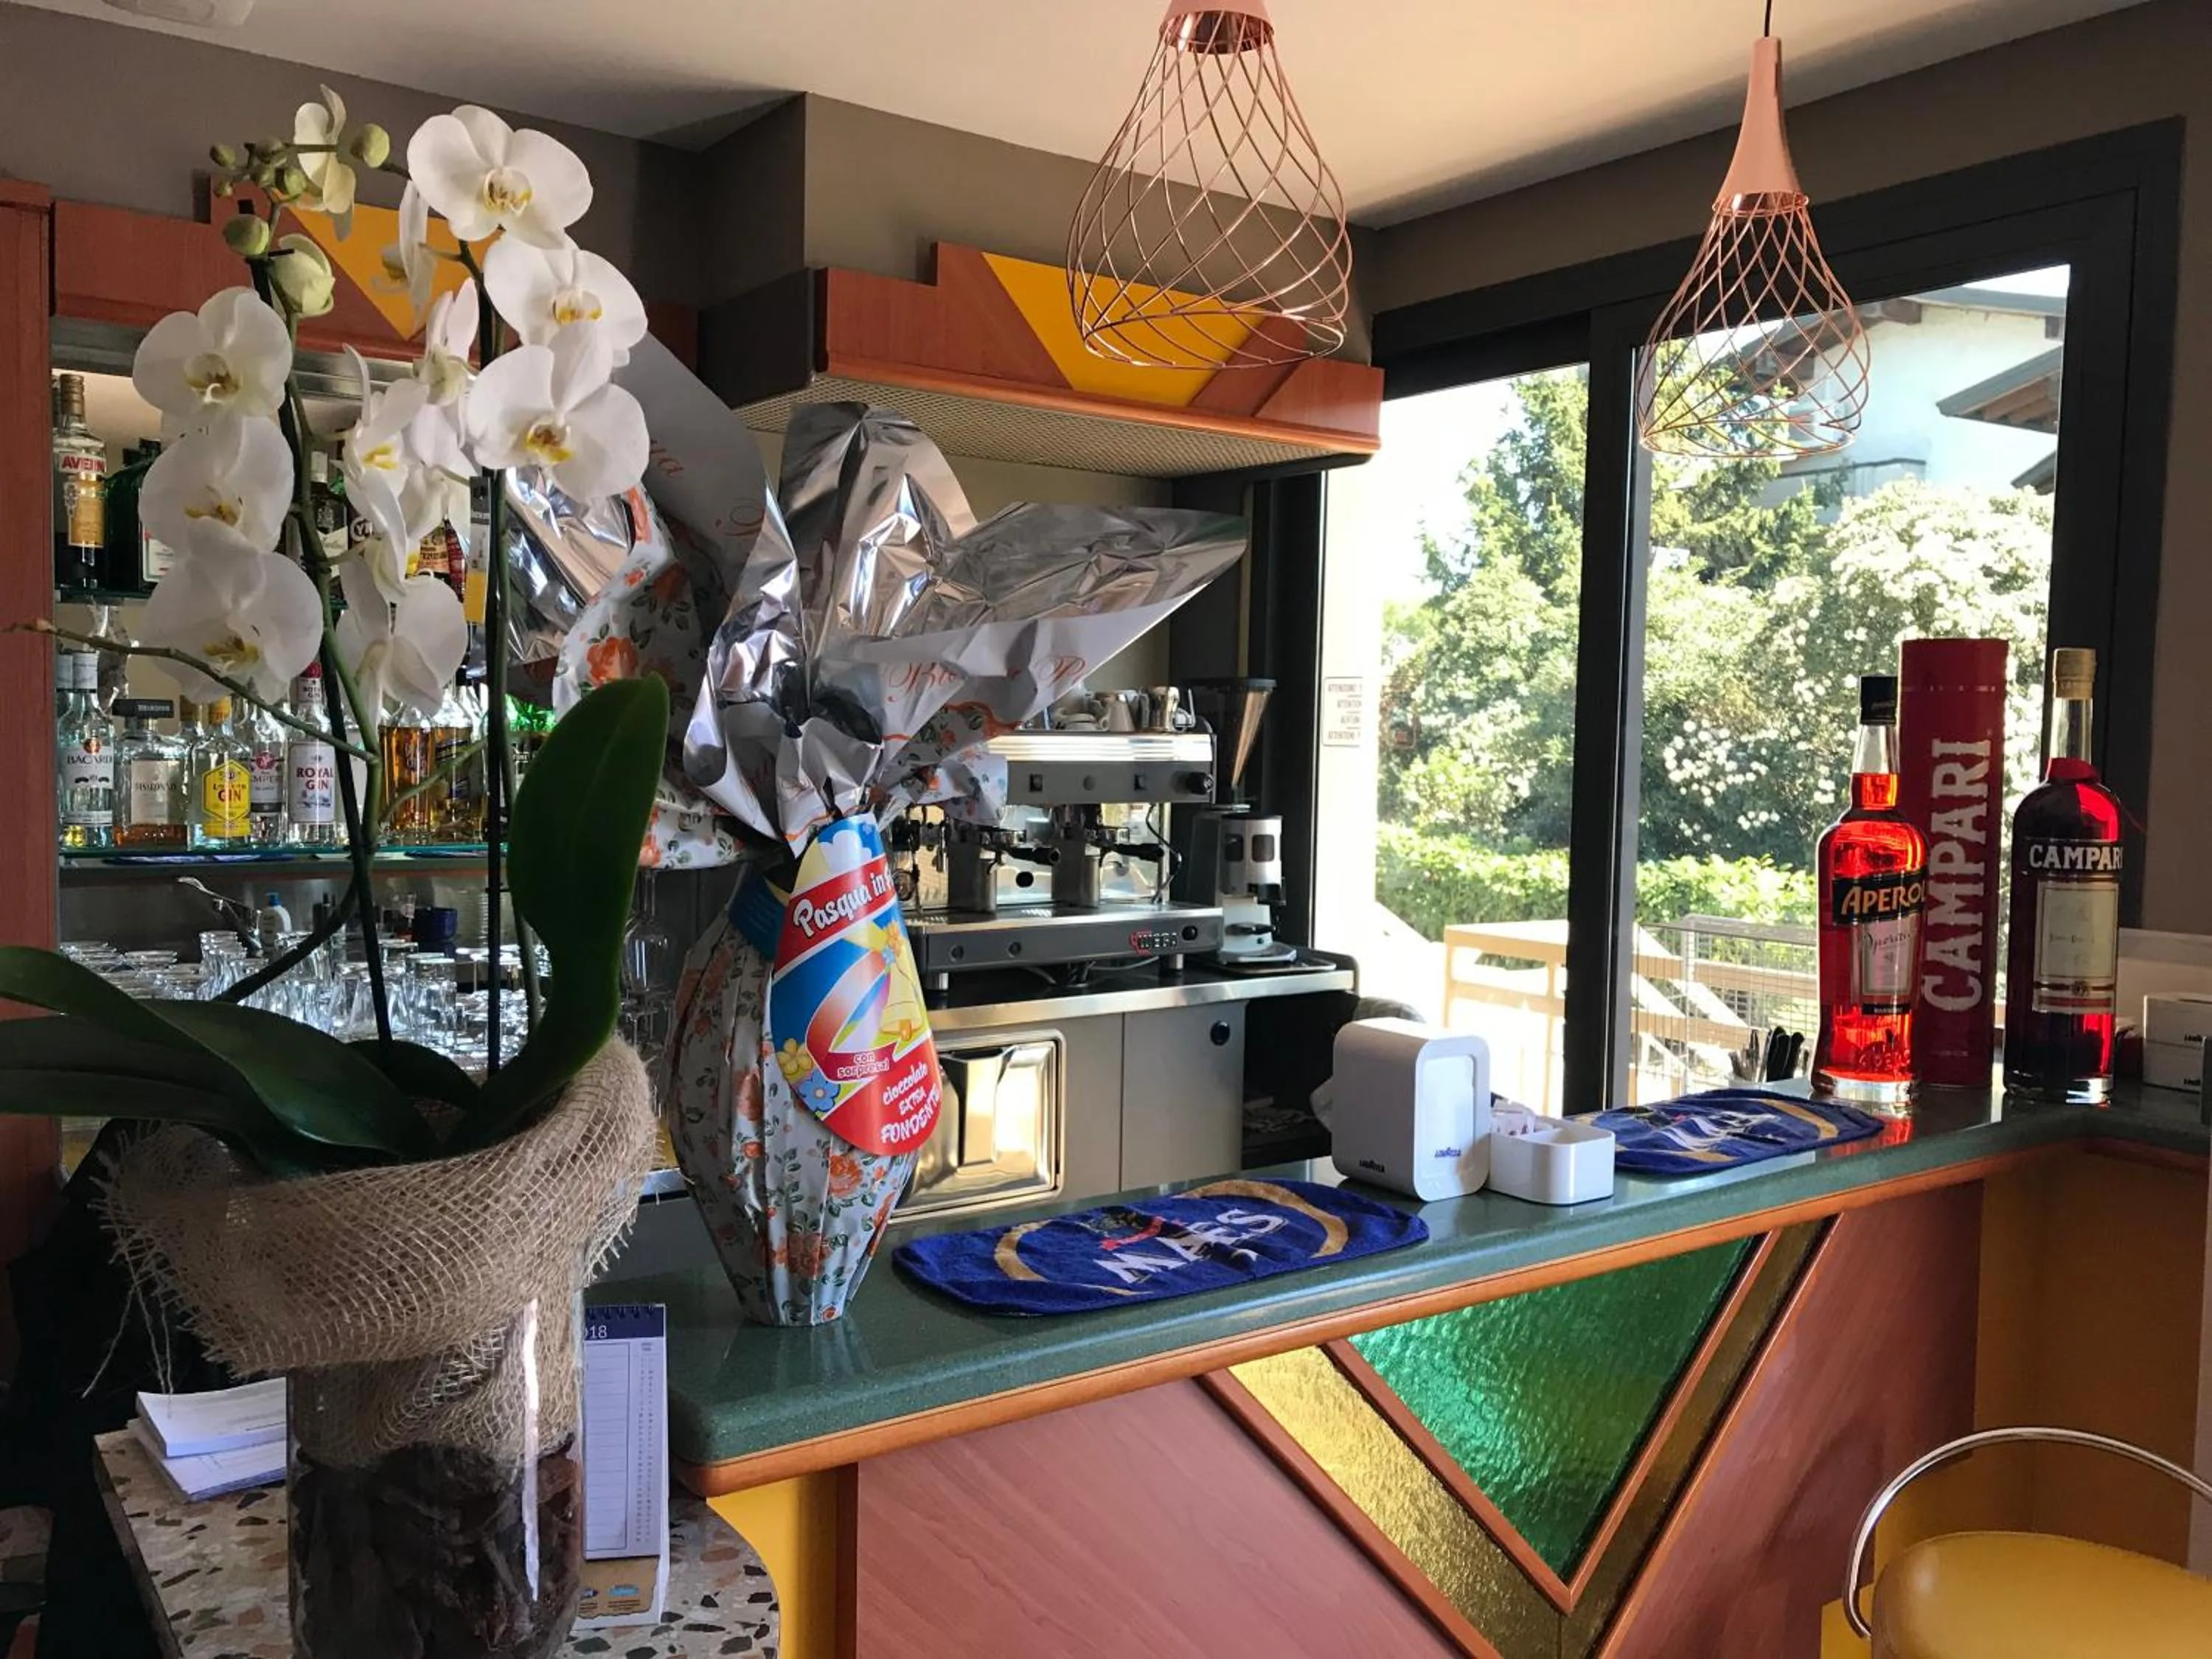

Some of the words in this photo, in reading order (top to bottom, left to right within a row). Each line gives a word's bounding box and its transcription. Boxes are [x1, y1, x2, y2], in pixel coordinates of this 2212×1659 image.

[296, 768, 333, 778] ROYAL
[305, 779, 329, 790] GIN
[218, 789, 241, 802] GIN
[1922, 738, 1990, 1012] CAMPARI
[793, 885, 873, 937] Pasqua
[870, 872, 885, 897] in
[854, 1051, 874, 1064] con
[837, 1058, 889, 1077] sorpresa!
[883, 1062, 928, 1105] cioccolato
[899, 1086, 927, 1115] EXTRA
